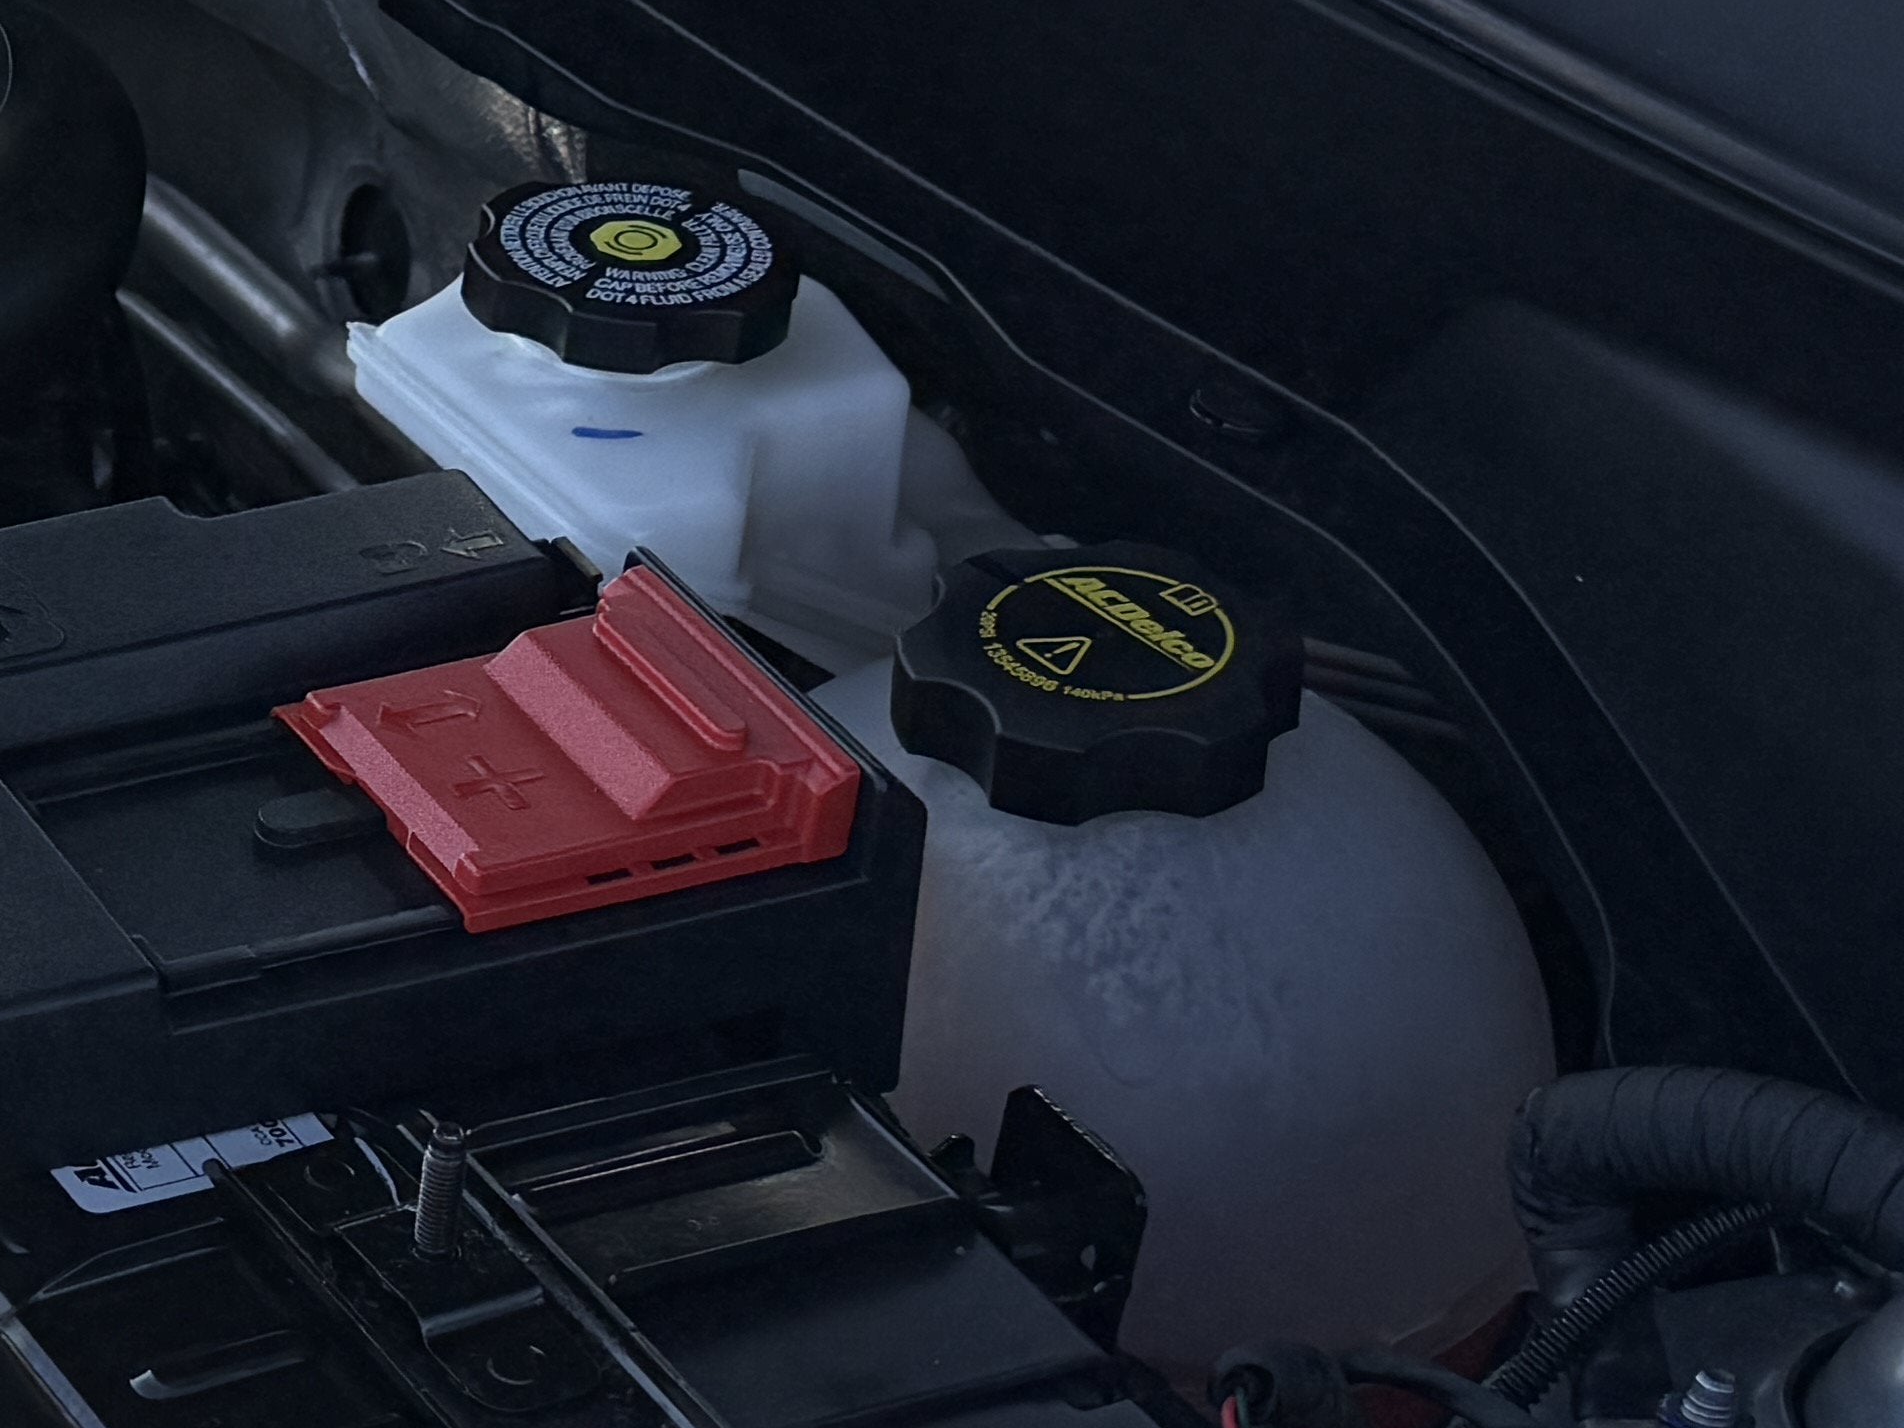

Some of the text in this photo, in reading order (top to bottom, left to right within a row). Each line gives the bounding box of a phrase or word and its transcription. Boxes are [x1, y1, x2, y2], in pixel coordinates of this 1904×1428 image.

[649, 196, 680, 207] DOT
[594, 278, 633, 292] CAP
[634, 279, 701, 294] BEFORE
[586, 288, 625, 302] DOT
[626, 294, 637, 304] 4
[640, 292, 694, 305] FLUID
[1063, 576, 1216, 669] ACDelco
